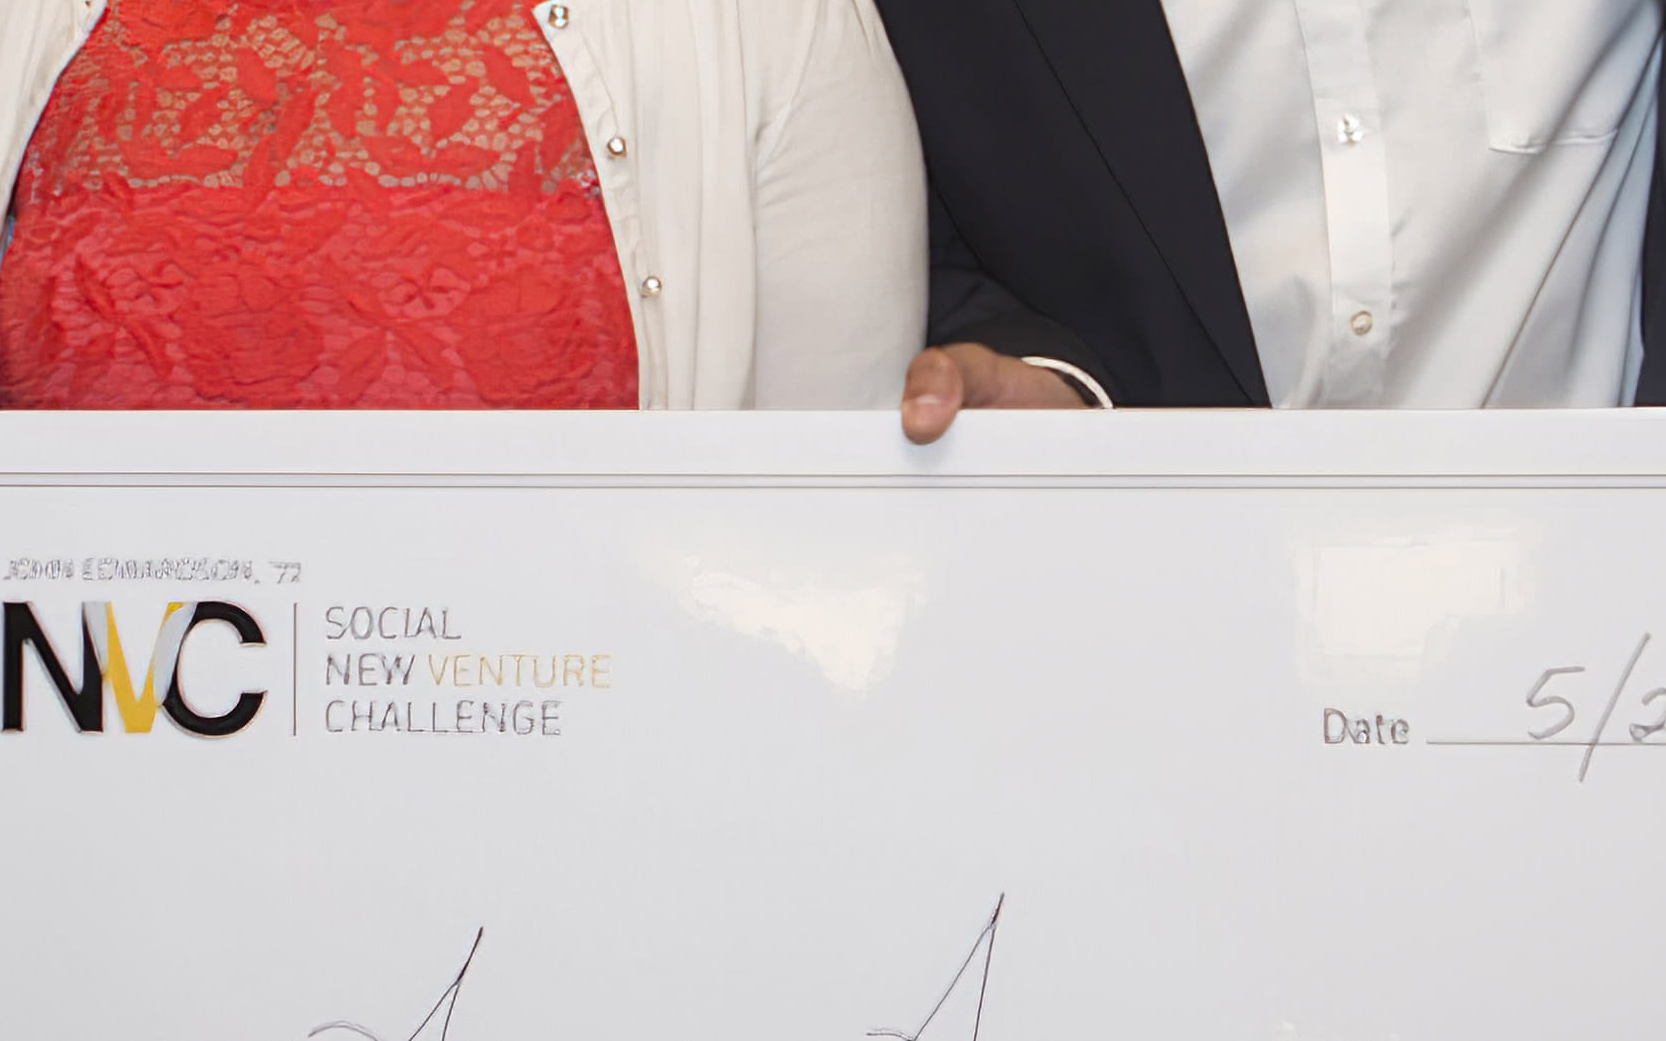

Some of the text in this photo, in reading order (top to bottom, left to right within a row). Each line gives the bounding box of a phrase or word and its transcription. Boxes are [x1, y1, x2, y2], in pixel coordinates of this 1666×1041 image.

[325, 606, 462, 640] SOCIAL
[0, 599, 269, 739] NVC
[325, 653, 613, 689] NEW VENTURE
[325, 699, 563, 736] CHALLENGE
[1321, 707, 1411, 746] Date
